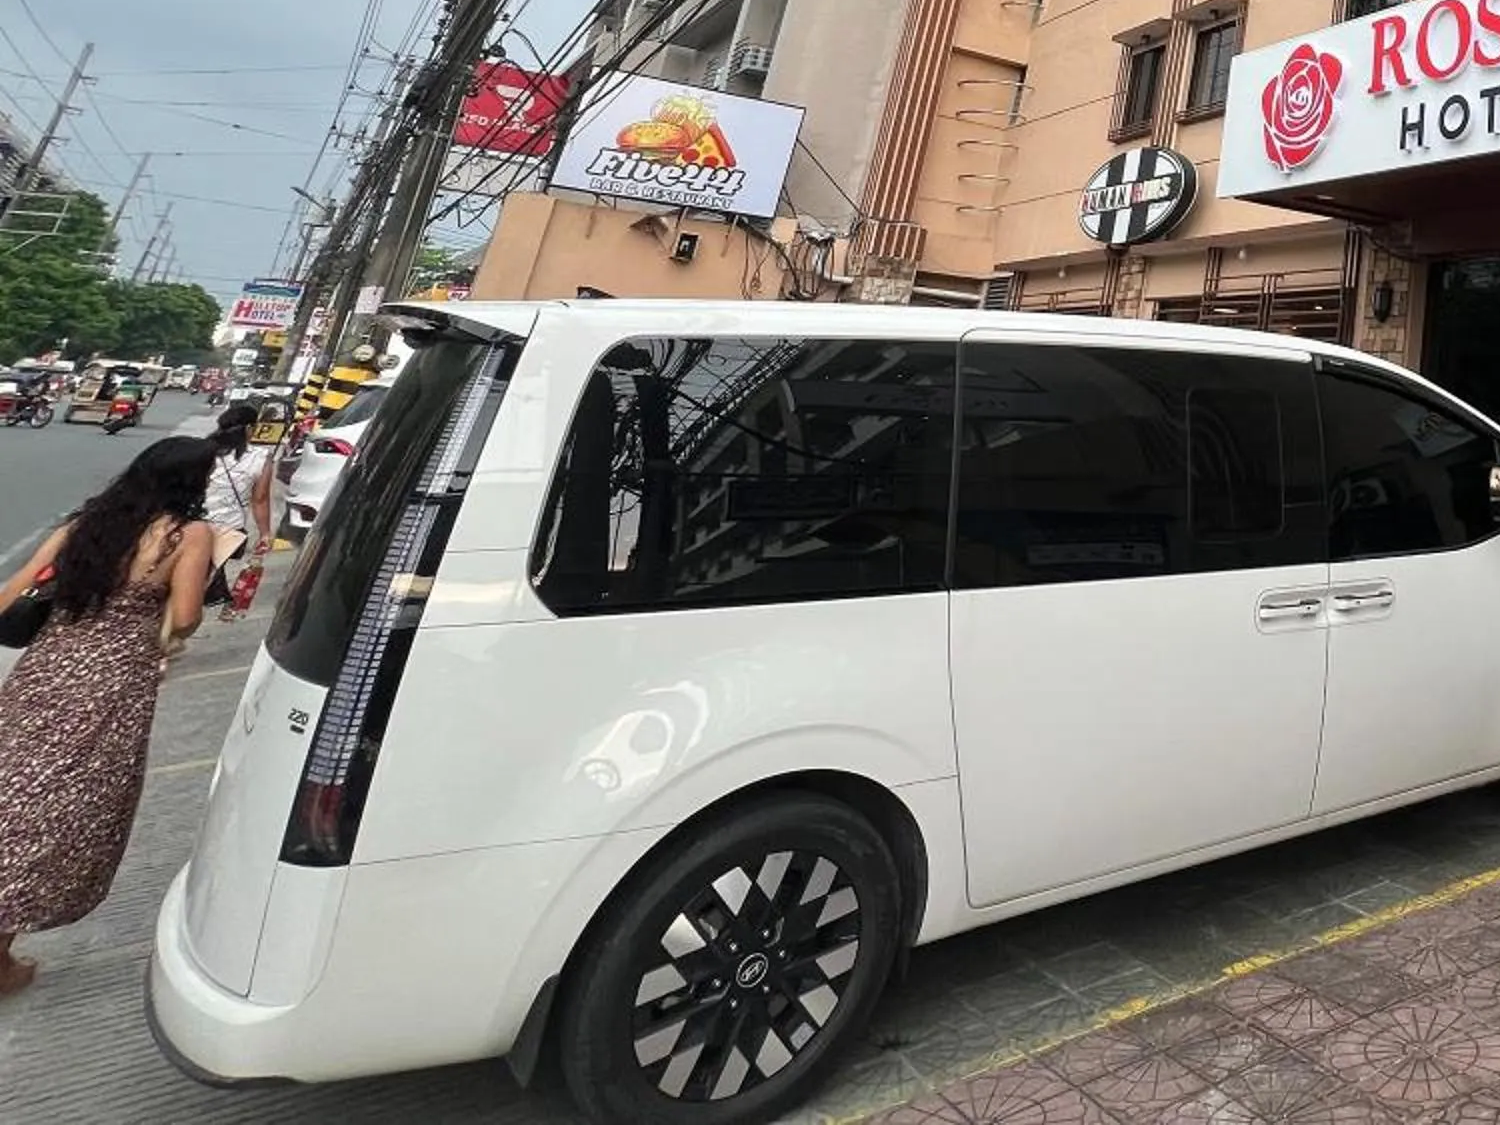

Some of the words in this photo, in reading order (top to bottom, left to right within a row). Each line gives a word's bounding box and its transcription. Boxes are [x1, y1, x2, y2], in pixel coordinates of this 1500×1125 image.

[590, 178, 623, 193] BAR
[641, 185, 733, 210] RESTAURANT
[287, 707, 309, 725] 220
